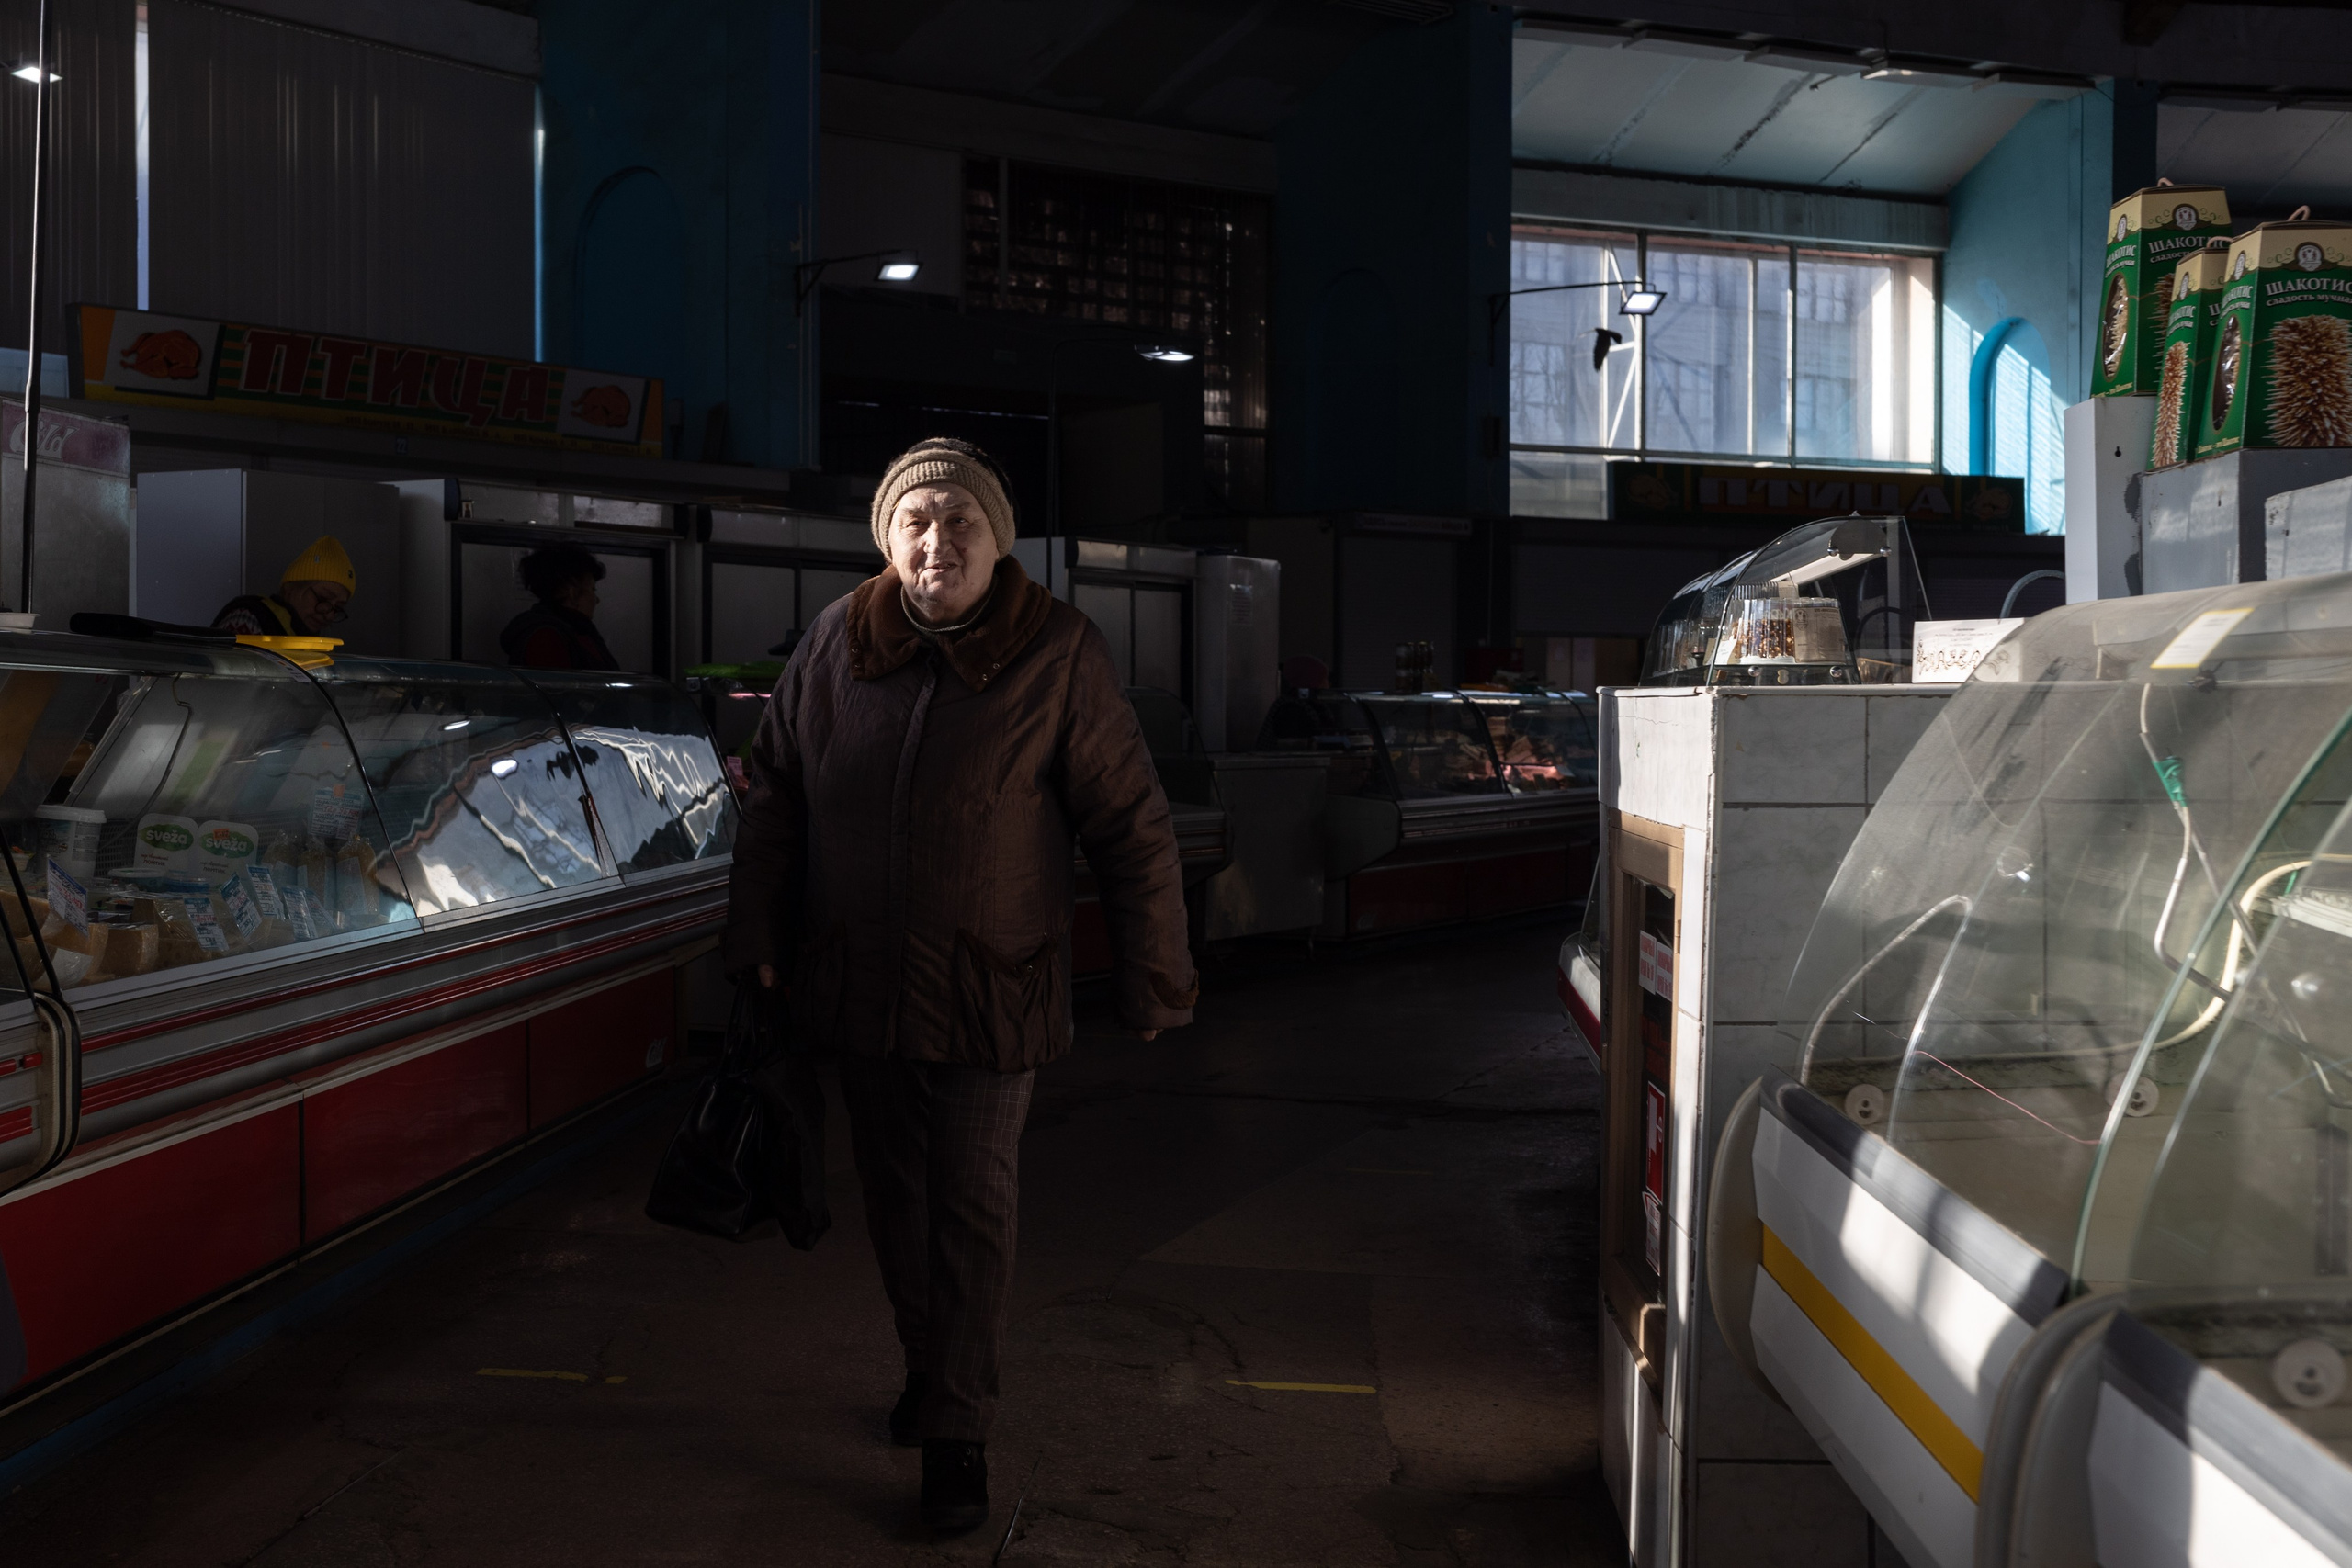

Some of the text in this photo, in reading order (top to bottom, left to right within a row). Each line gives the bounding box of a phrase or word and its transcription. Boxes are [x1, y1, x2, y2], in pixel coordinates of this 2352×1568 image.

[2265, 277, 2352, 296] ШАКОТИС
[2266, 295, 2315, 307] сладость
[237, 329, 550, 426] ПТИЦА
[1698, 476, 1953, 514] ПТИЦА
[146, 829, 188, 845] sveža
[205, 837, 248, 852] sveža
